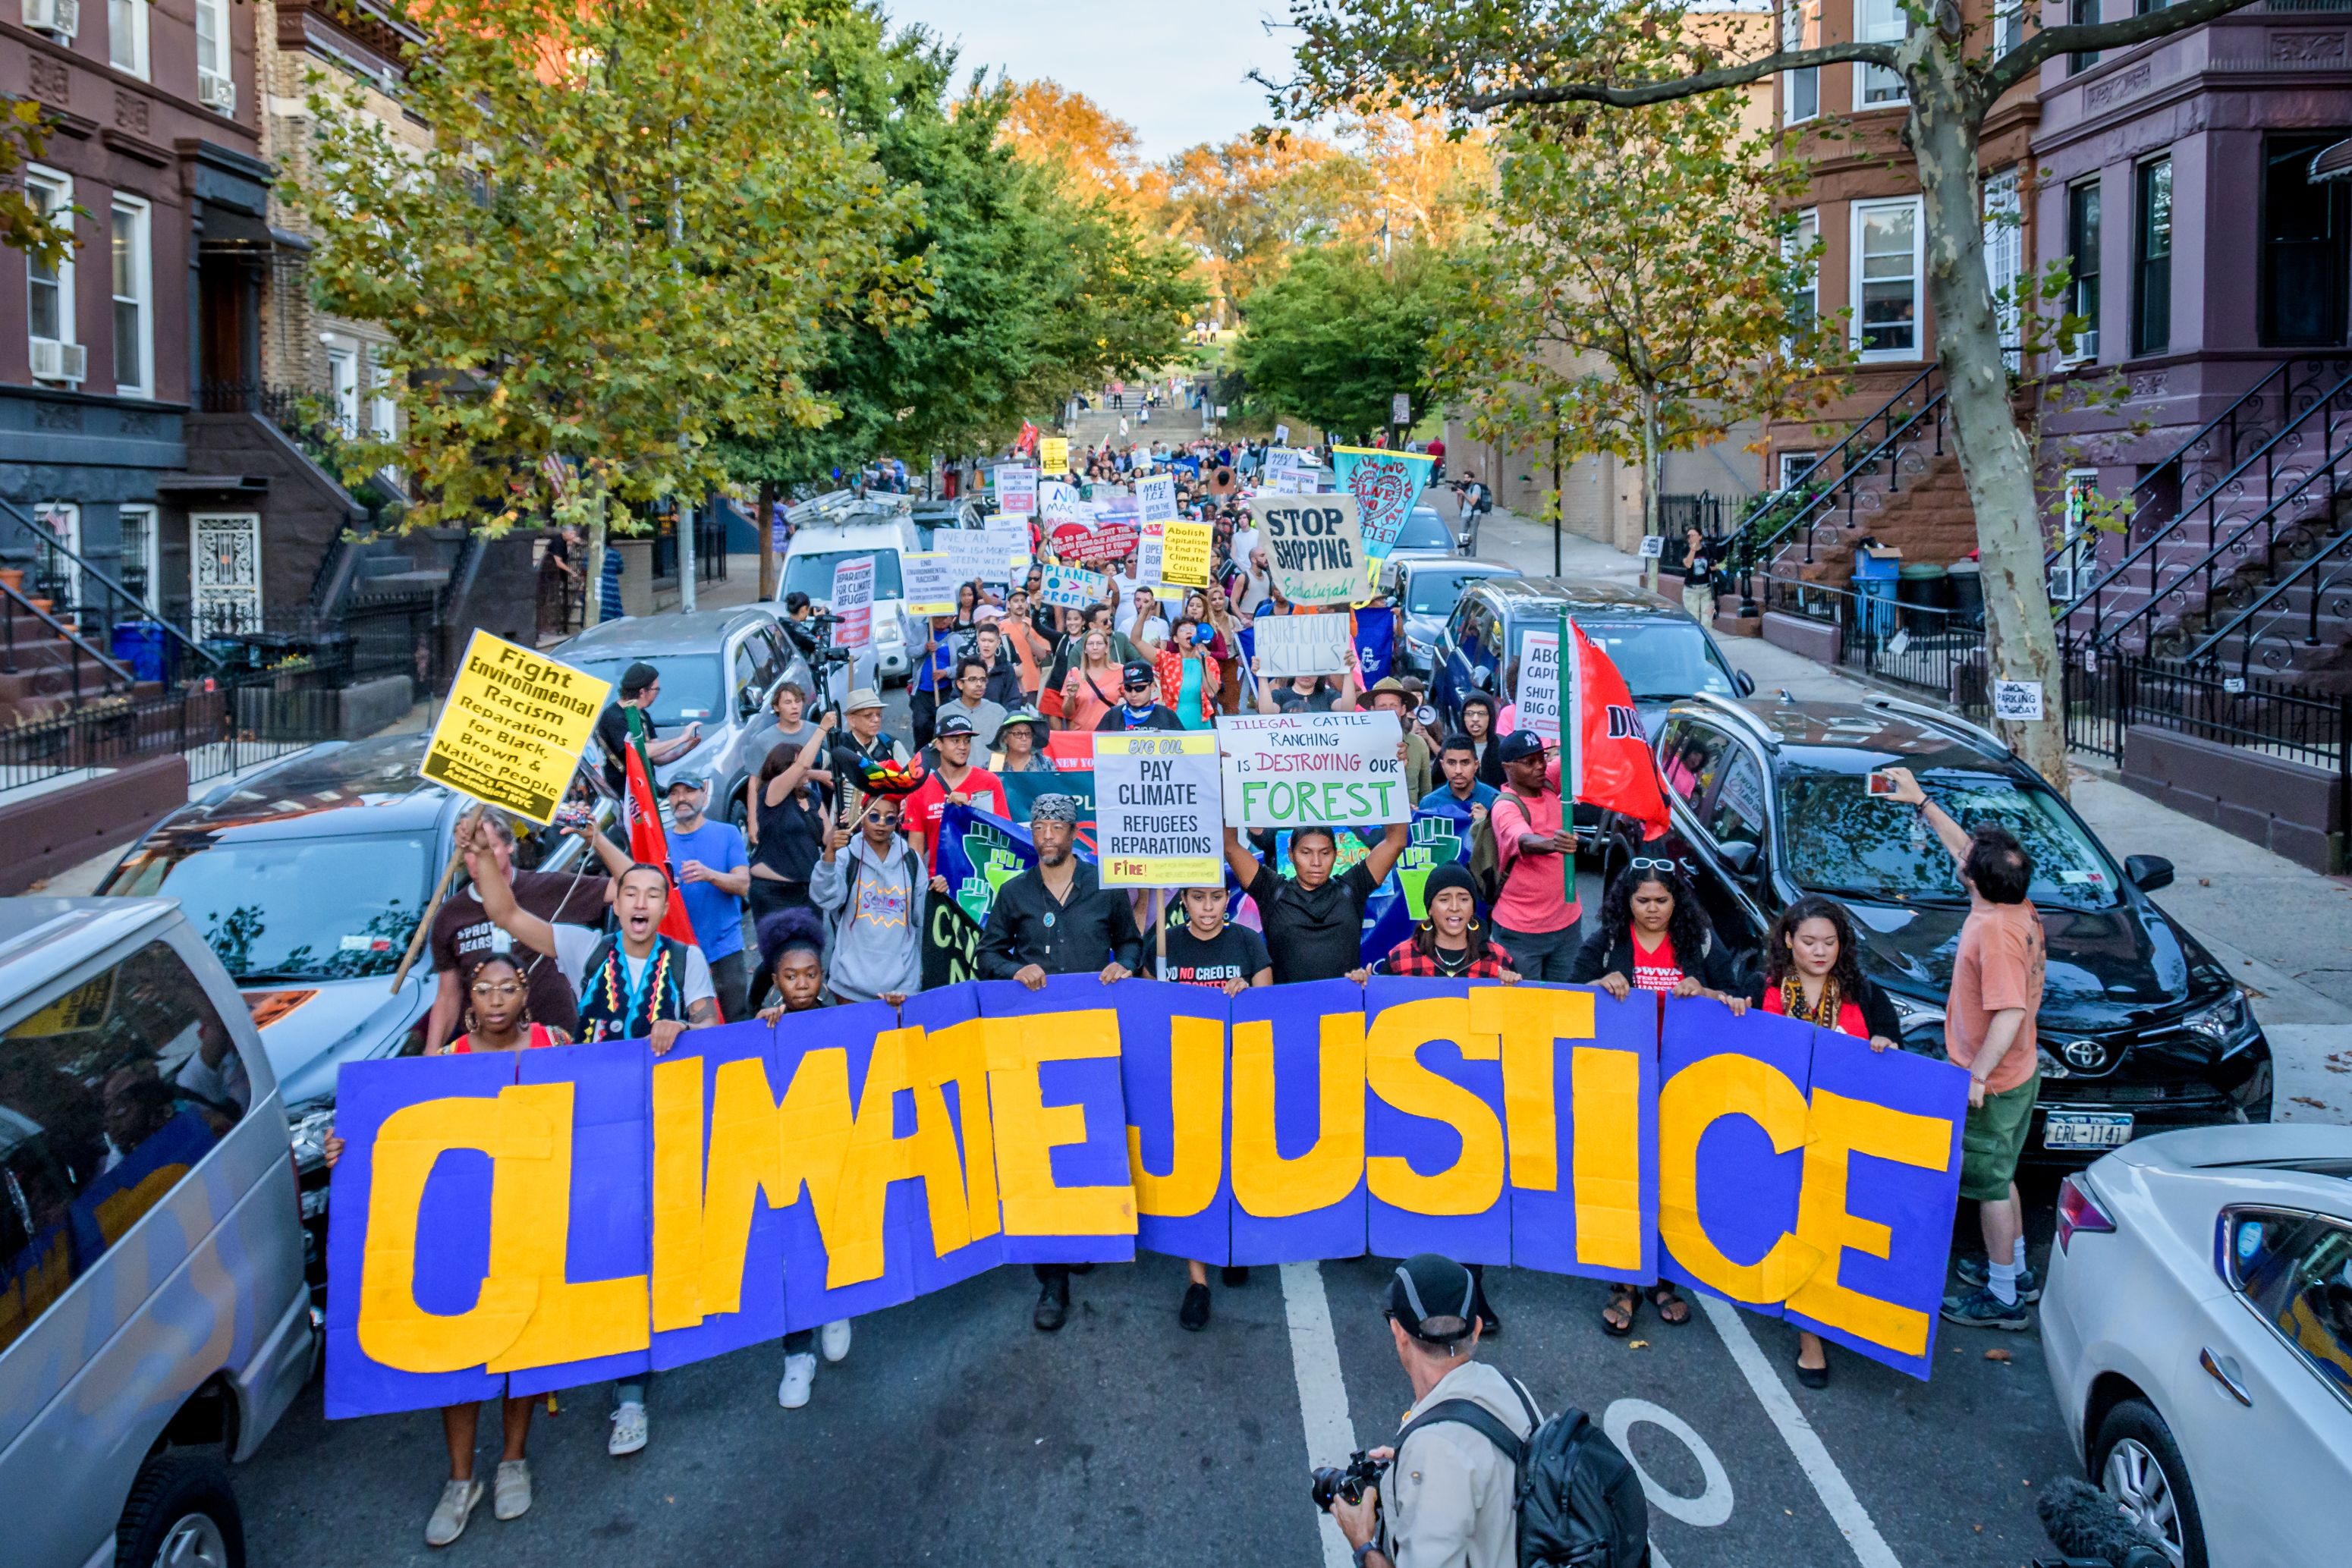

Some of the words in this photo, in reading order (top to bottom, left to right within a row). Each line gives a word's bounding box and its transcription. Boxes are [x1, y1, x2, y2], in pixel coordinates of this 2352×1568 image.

[1053, 487, 1075, 504] NO
[1143, 481, 1168, 493] MELT
[1146, 504, 1160, 513] OPEN
[1160, 502, 1170, 511] THE
[1146, 511, 1171, 521] BORDERS!
[1266, 508, 1343, 536] STOP
[942, 533, 961, 542] WE
[964, 533, 989, 543] CAN
[1168, 527, 1205, 537] Abolish
[1165, 536, 1209, 546] Capitalism
[940, 545, 964, 553] GROW
[986, 546, 1011, 555] MORE
[1169, 554, 1205, 563] Climate
[1272, 538, 1353, 571] SHOPPING
[837, 569, 871, 583] REPARATIONS
[951, 568, 974, 577] ANTS
[1046, 565, 1105, 586] PLANET
[1173, 564, 1198, 572] Crisis
[836, 584, 846, 595] FOR
[848, 580, 870, 592] CLIMATE
[1043, 590, 1098, 607] PROFIT
[1269, 644, 1341, 672] KILLS
[498, 647, 572, 688] Fight
[469, 655, 594, 718] Environmental
[1526, 686, 1555, 699] SHUT
[483, 685, 564, 725] Racism
[1998, 693, 2036, 702] PARKING
[1524, 701, 1544, 714] BIG
[1548, 705, 1560, 716] OI
[460, 696, 568, 746] Reparations
[1231, 718, 1302, 731] ILLEGAL
[1313, 715, 1371, 727] CATTLE
[469, 720, 492, 735] for
[496, 731, 548, 759] Black,
[1128, 740, 1157, 755] BIG
[1159, 740, 1184, 755] OIL
[1271, 733, 1340, 747] RANCHING
[460, 733, 521, 766] Brown,
[529, 761, 540, 772] &
[435, 740, 492, 772] Native
[498, 767, 557, 797] People
[1055, 759, 1077, 768] NEW
[1081, 759, 1094, 768] YO
[1140, 760, 1173, 782] PAY
[1237, 760, 1250, 772] IS
[1256, 753, 1361, 772] DESTROYING
[1369, 759, 1398, 773] OUR
[443, 769, 505, 799] Assemblies
[508, 794, 534, 809] NYC
[448, 762, 495, 787] People's
[495, 781, 533, 799] Power
[1118, 784, 1196, 806] CLIMATE
[1243, 781, 1396, 822] FOREST
[1124, 815, 1197, 832] REFUGEES
[1112, 837, 1211, 855] REPARATIONS
[1166, 967, 1178, 979] YO
[1179, 967, 1194, 979] NO
[1196, 965, 1224, 980] CREO
[1226, 965, 1241, 978] EN
[360, 1008, 1138, 1374] CLIMATE
[1126, 987, 1951, 1356] JUSTICE
